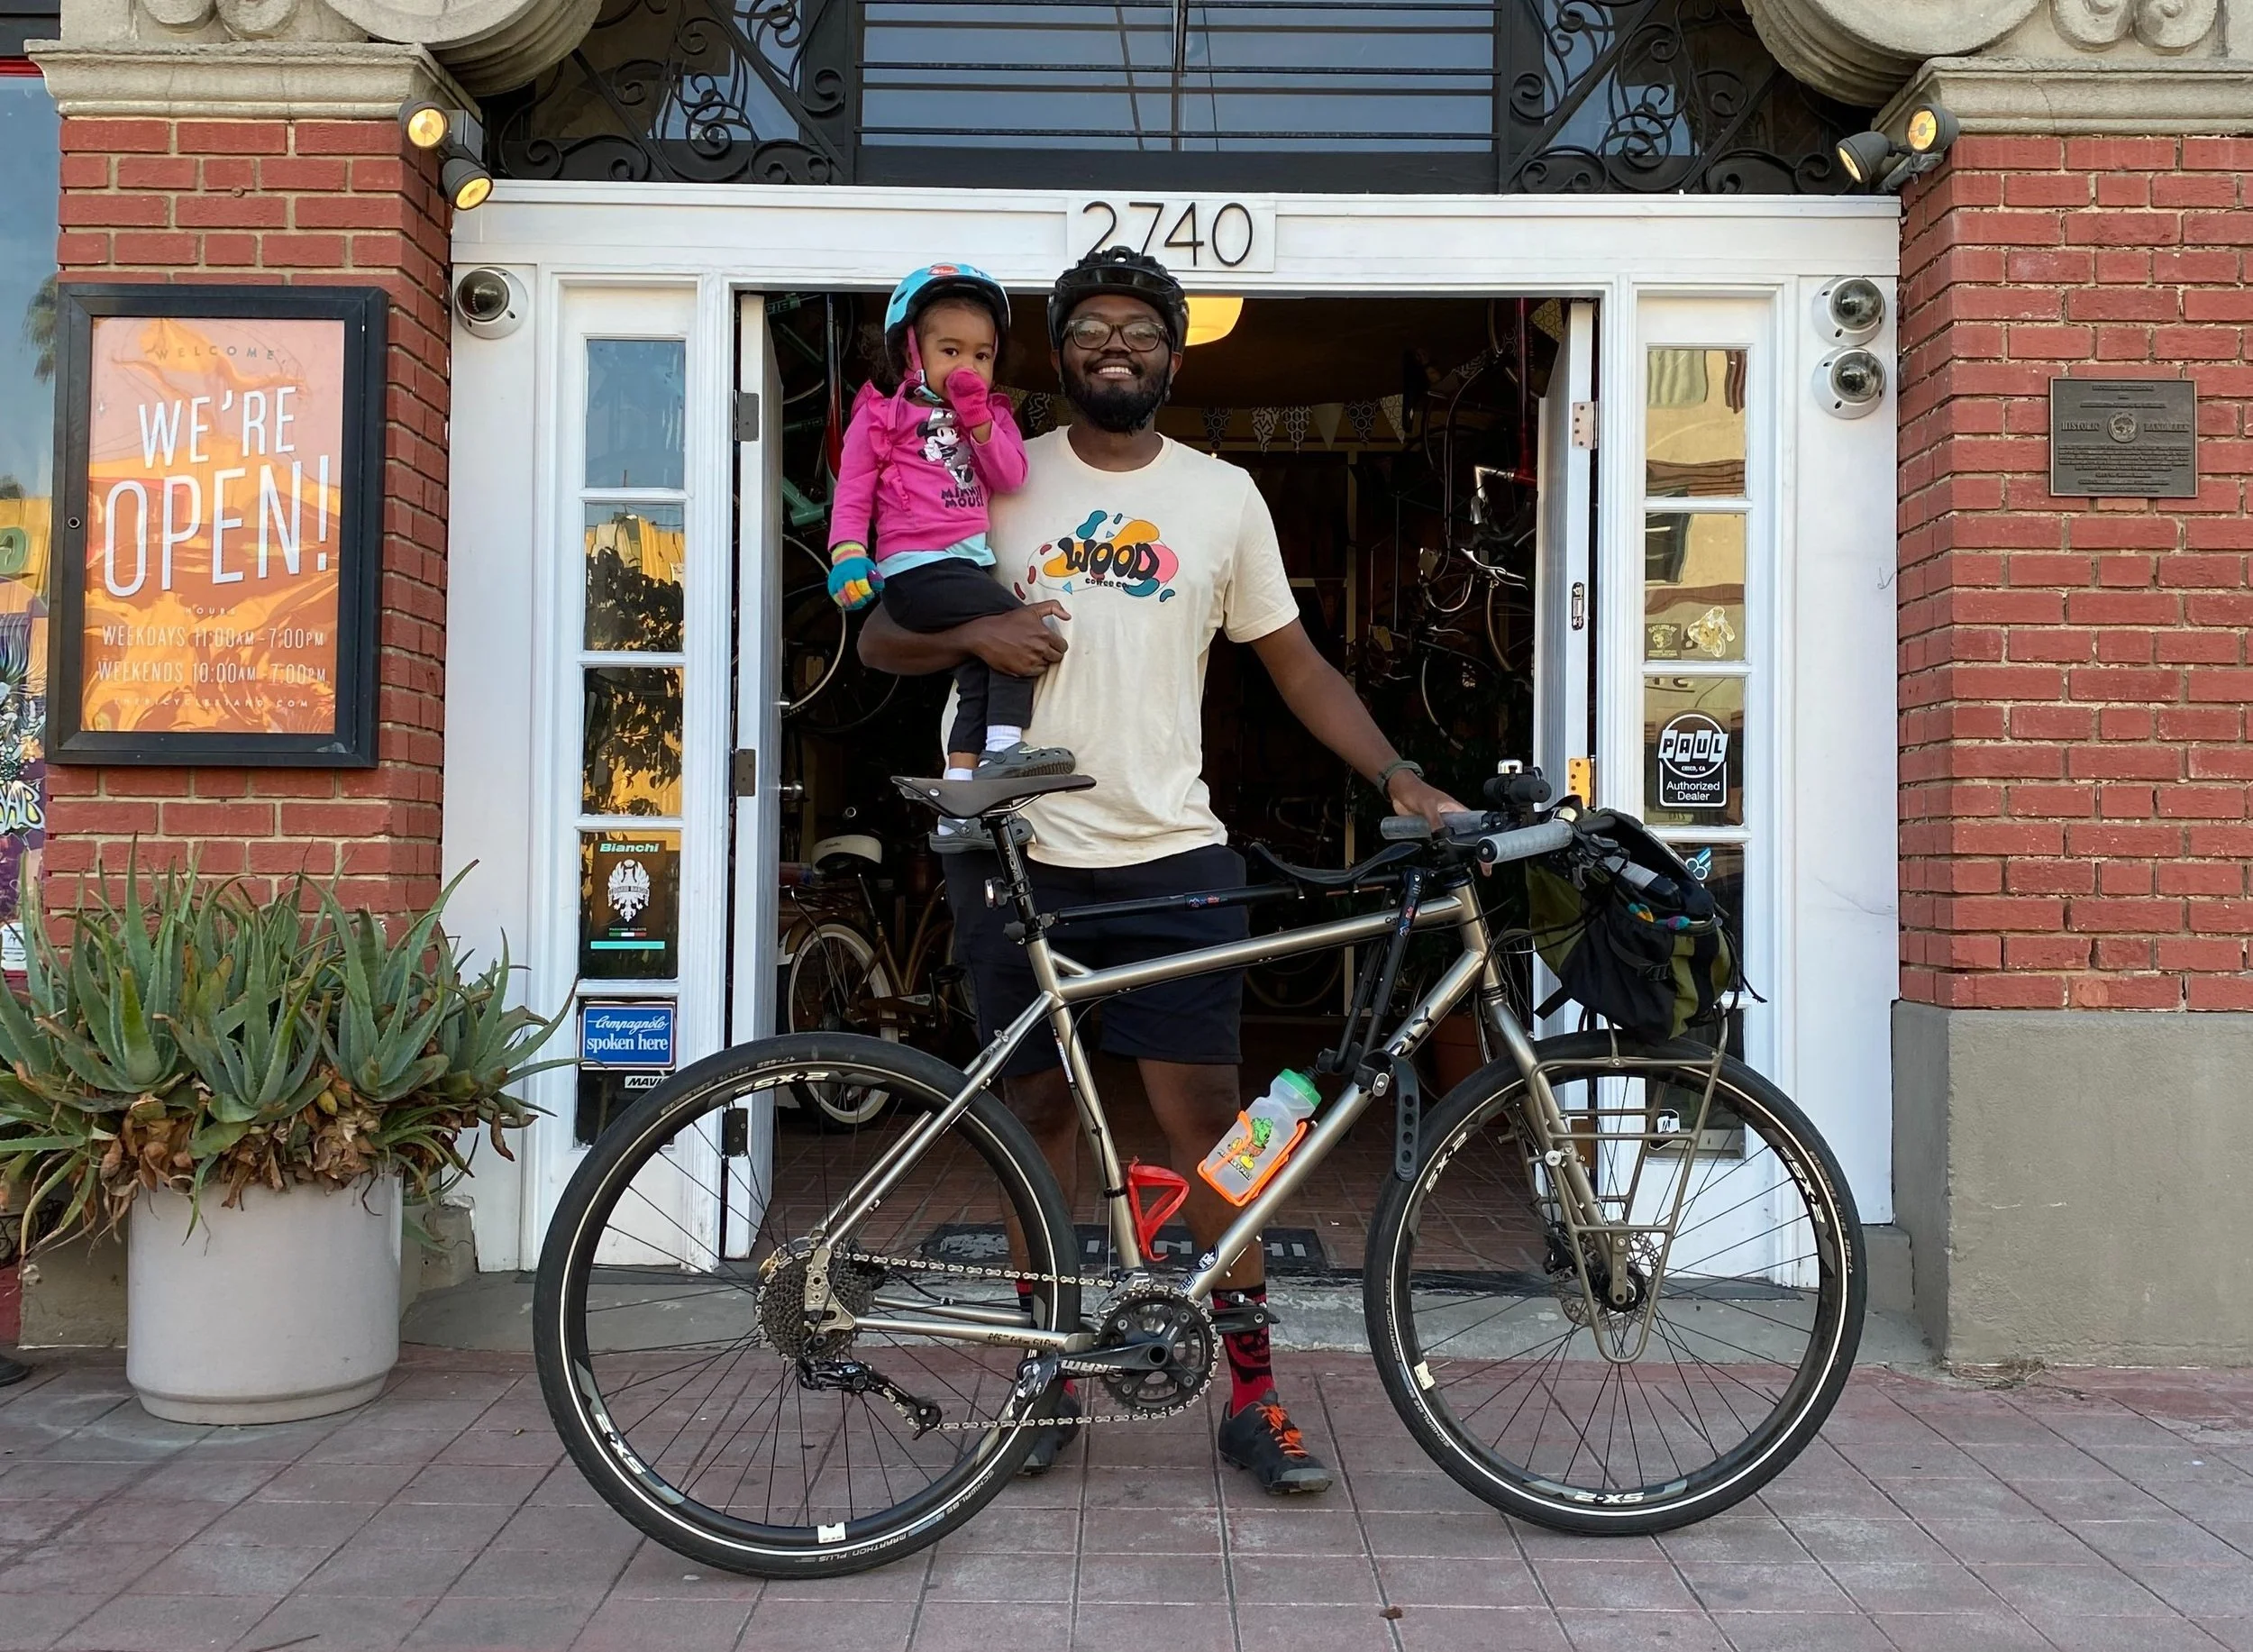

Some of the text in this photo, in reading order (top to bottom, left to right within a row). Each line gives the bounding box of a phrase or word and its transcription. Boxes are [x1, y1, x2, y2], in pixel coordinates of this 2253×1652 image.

[1083, 201, 1253, 267] 2740
[138, 386, 296, 469] WE'RE
[105, 455, 329, 597] OPEN!
[1057, 537, 1160, 580] WOOD
[185, 607, 235, 615] HOURS
[102, 625, 185, 647] WEEKDAYS
[269, 628, 324, 648] 7:00PM
[97, 662, 184, 682] WEEKENDS
[193, 662, 256, 683] 10:00AM
[270, 663, 326, 684] 7:00PM
[1661, 735, 1724, 756] PAUL
[1666, 780, 1720, 790] Authorized
[1677, 791, 1710, 800] Dealer
[599, 843, 660, 853] Bianchi
[587, 1015, 669, 1036] Campagnolo
[587, 1033, 669, 1054] spoken here
[627, 1077, 663, 1087] MAVI
[1426, 1131, 1467, 1193] SX-2
[1788, 1161, 1826, 1224] SX-2
[1385, 1310, 1400, 1361] MARATHON
[1061, 1359, 1123, 1377] SRAM
[1413, 1399, 1452, 1448] SCHWALBE
[595, 1413, 646, 1474] SX-2
[1574, 1491, 1645, 1504] SX-2
[818, 1469, 994, 1563] SCHWALBE MARATHON PLUS
